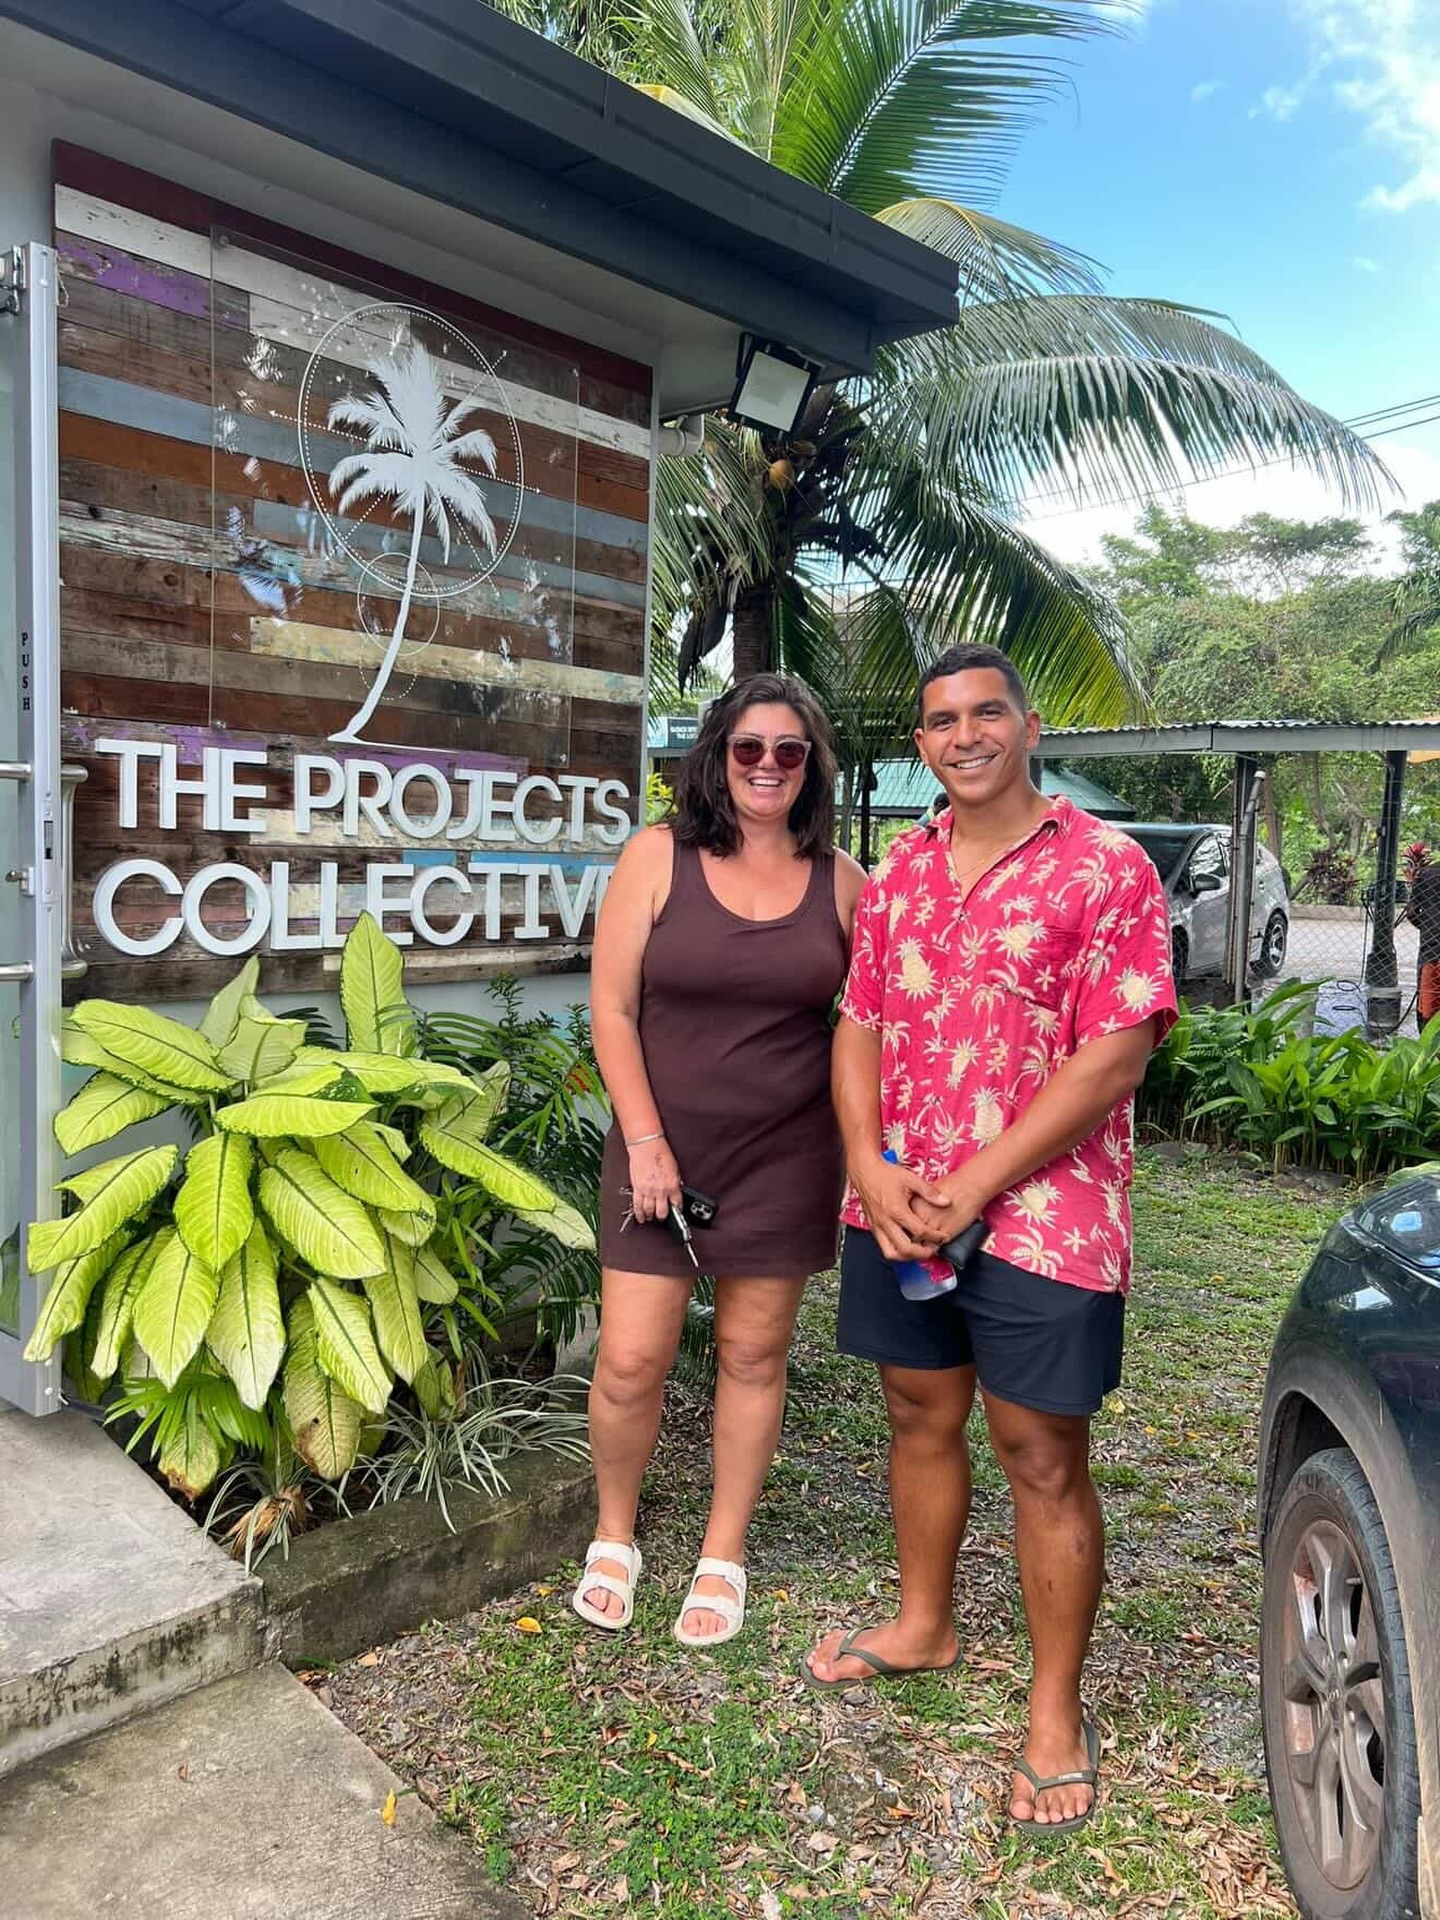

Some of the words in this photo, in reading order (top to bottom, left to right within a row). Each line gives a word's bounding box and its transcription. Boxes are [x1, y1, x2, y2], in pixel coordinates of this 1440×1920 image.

[21, 632, 31, 711] PUSH
[94, 738, 268, 833] THE
[293, 753, 632, 846] PROJECTS
[92, 858, 615, 957] COLLECTIV
